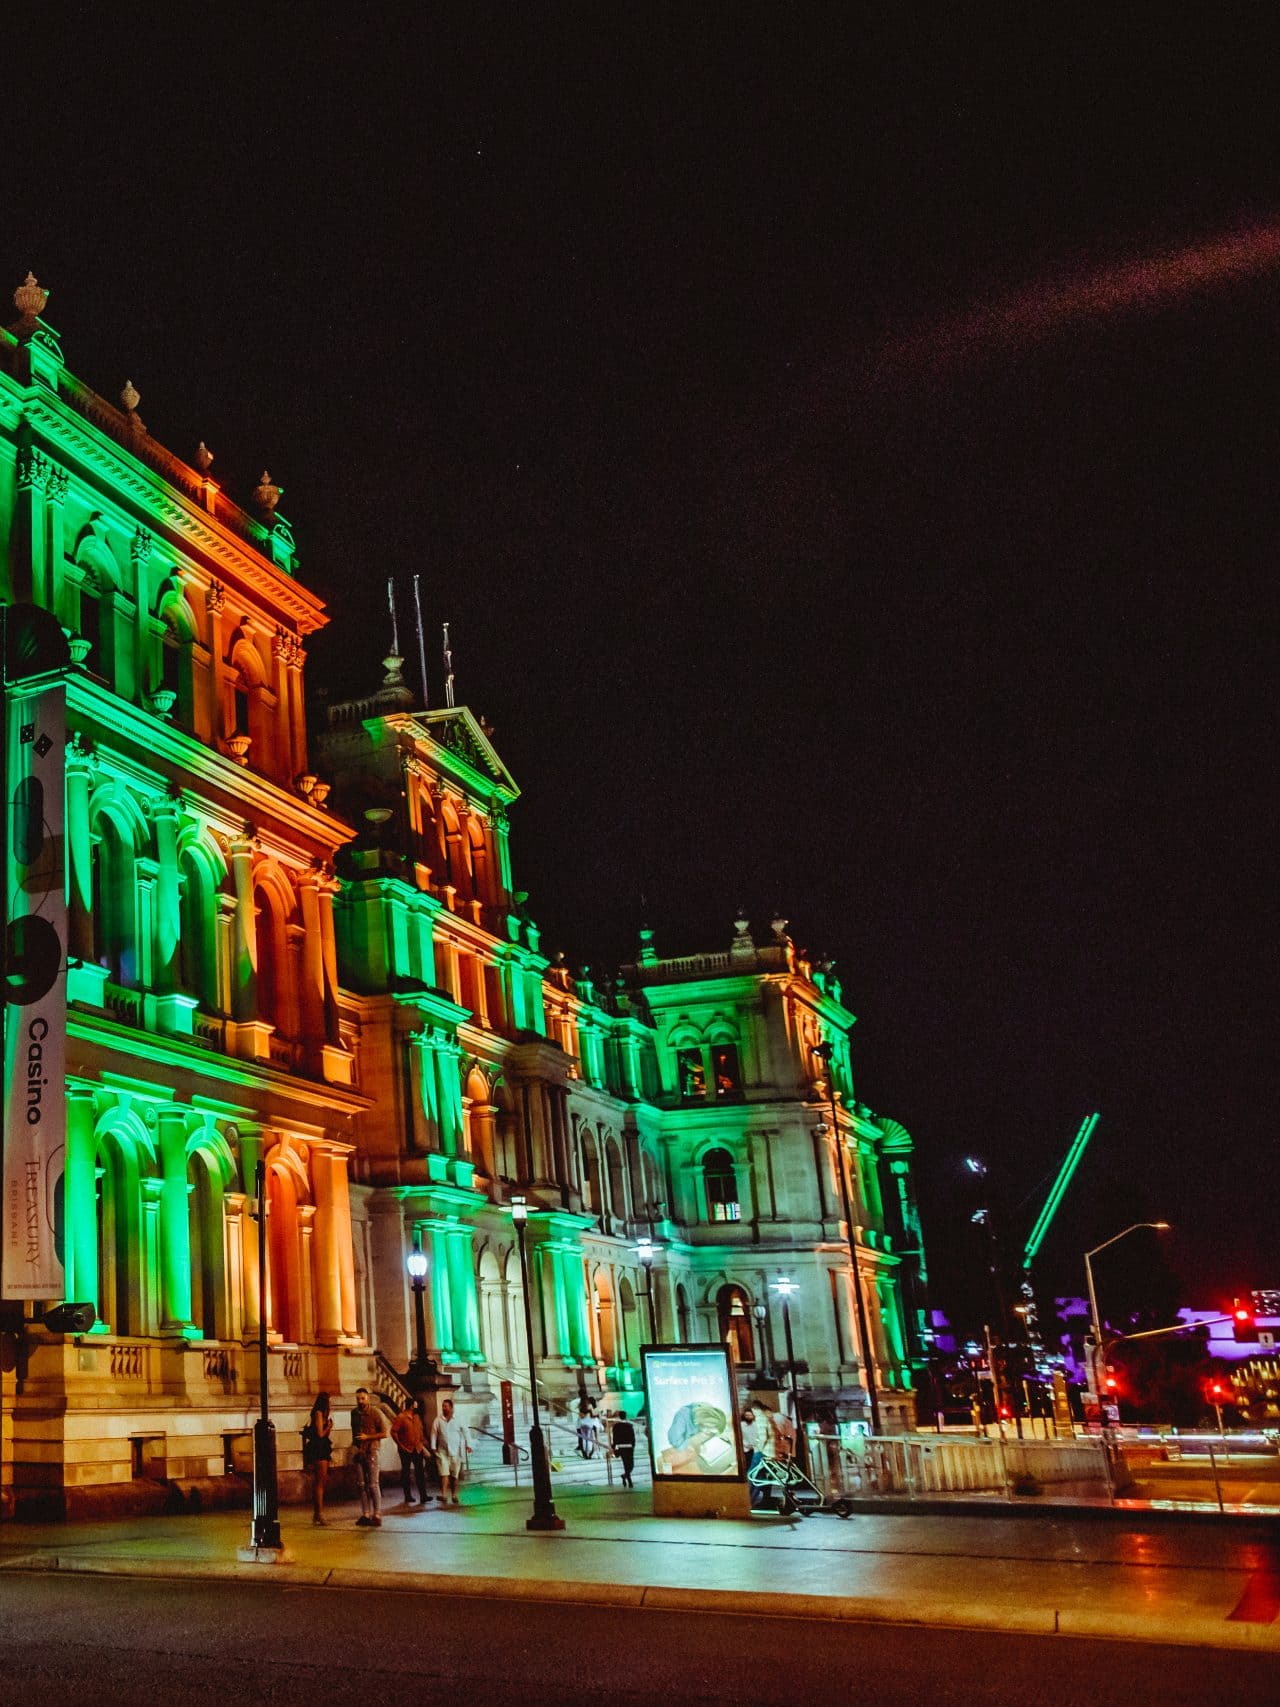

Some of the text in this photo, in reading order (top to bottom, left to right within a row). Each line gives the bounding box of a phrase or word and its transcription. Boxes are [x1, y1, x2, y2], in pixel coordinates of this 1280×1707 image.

[27, 1017, 49, 1126] Casino
[25, 1155, 40, 1269] TREASURY
[653, 1375, 689, 1385] Surface
